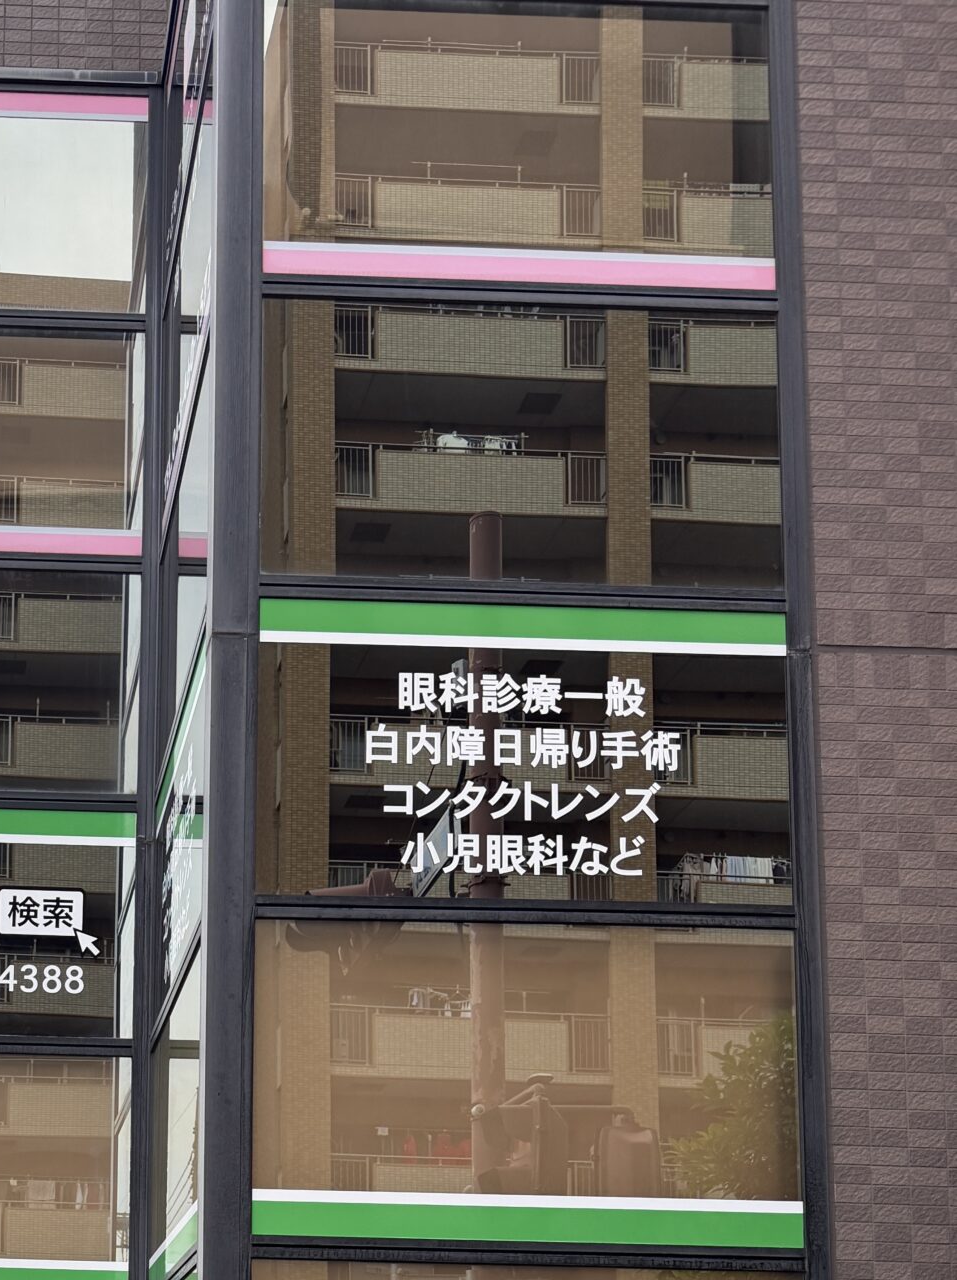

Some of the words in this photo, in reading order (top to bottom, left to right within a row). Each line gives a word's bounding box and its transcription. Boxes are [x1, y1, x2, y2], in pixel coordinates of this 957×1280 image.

[397, 672, 646, 718] 眼科診療一般
[364, 723, 682, 772] 白内障日帰り手術
[382, 780, 660, 824] コンタクトレンズ
[400, 832, 646, 876] 小児眼科など
[7, 894, 75, 929] 検索
